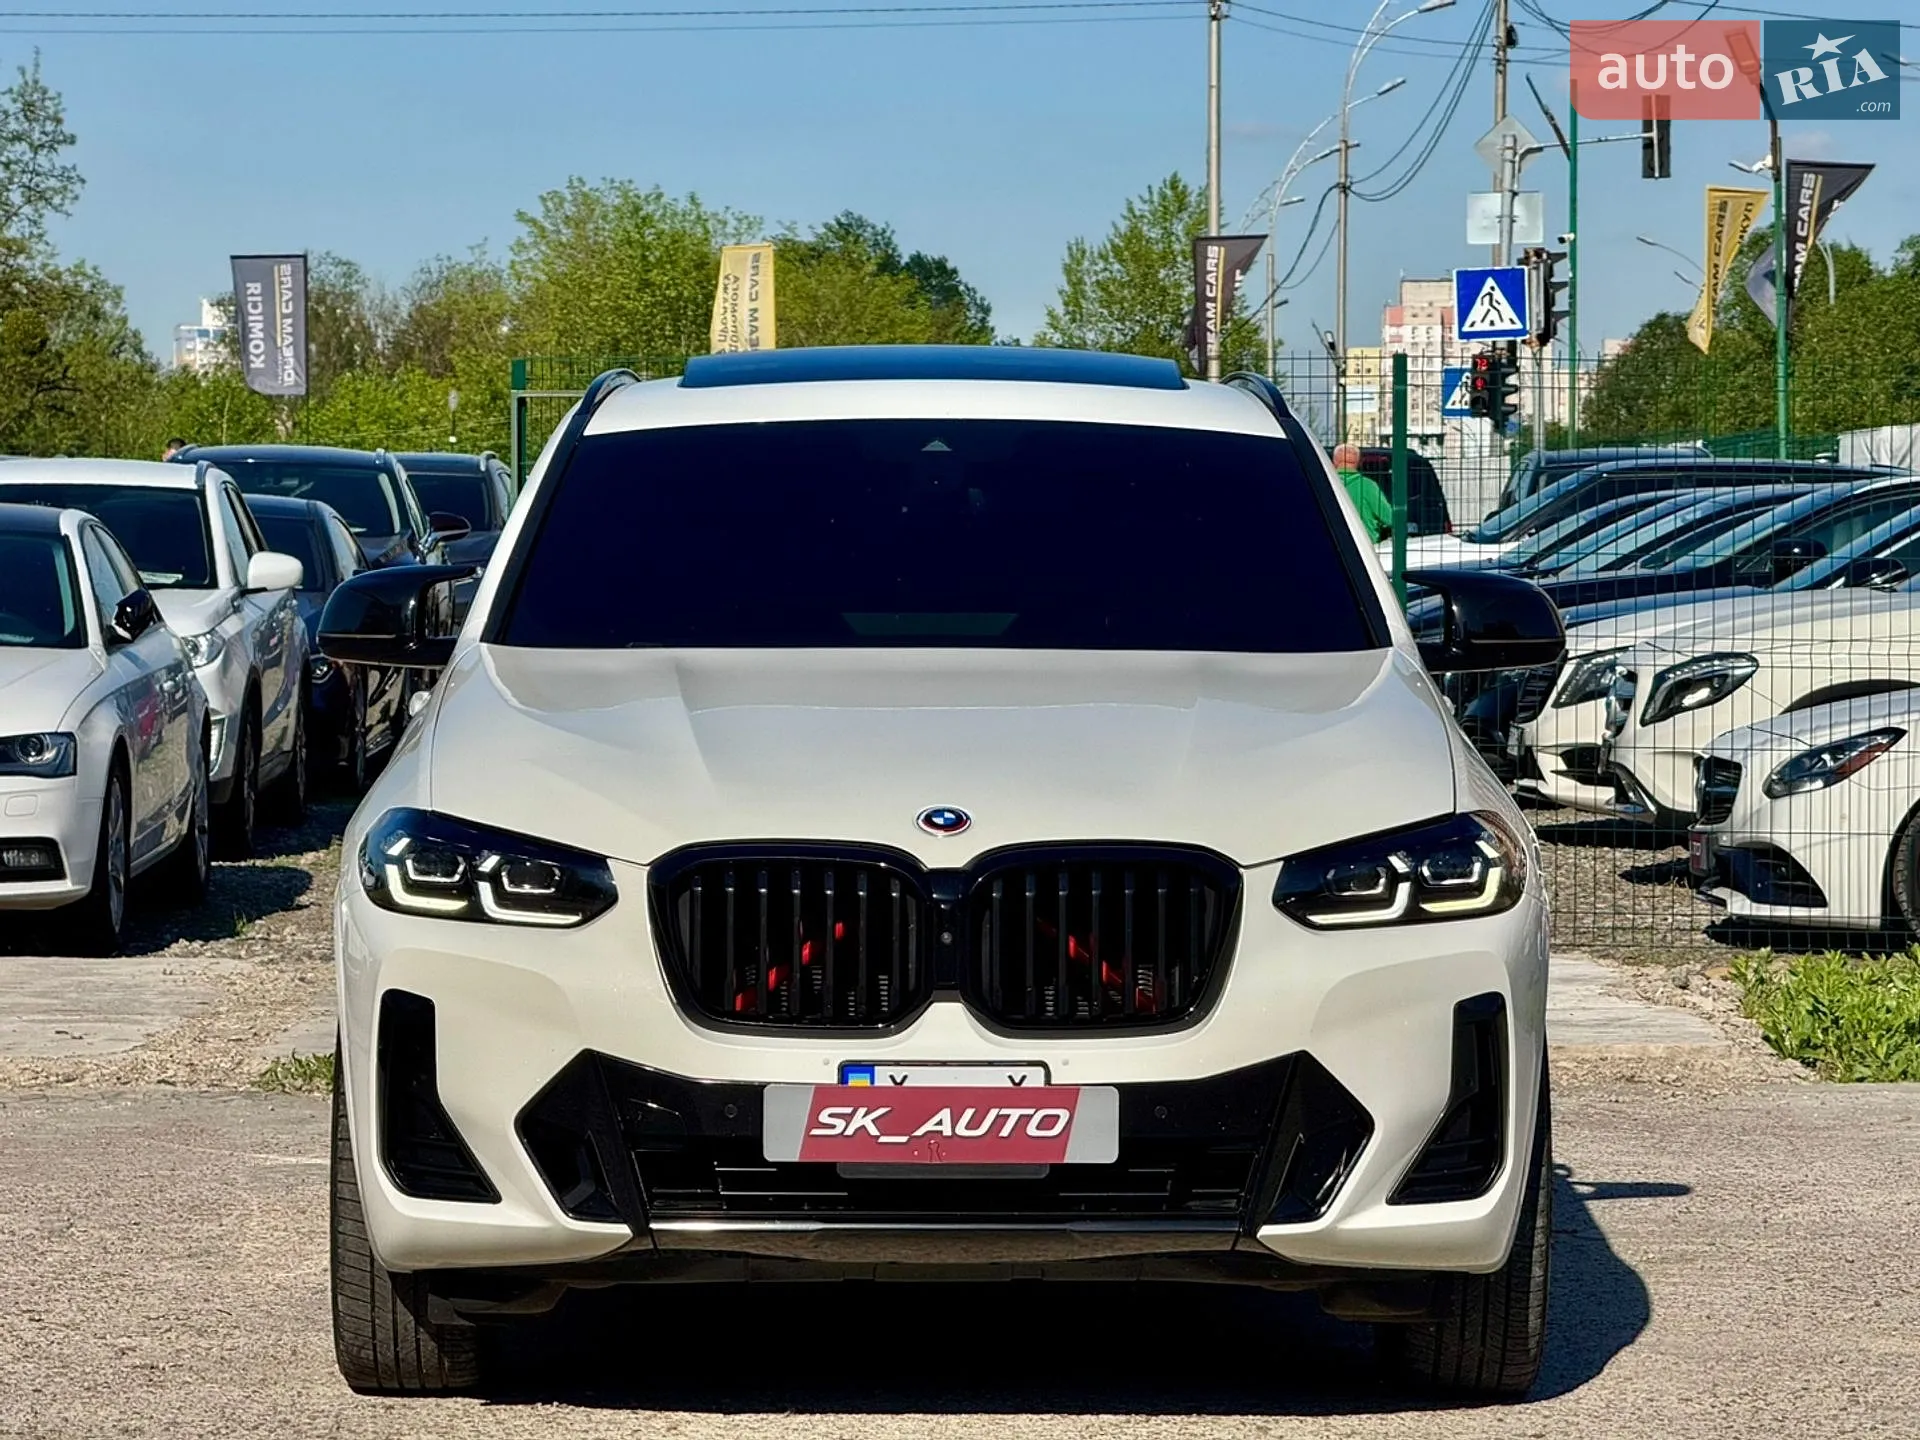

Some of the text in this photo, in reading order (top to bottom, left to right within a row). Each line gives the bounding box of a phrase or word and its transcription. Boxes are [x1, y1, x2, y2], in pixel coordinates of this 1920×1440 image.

[1714, 200, 1728, 257] CARS
[1796, 172, 1816, 237] CARS
[1206, 245, 1219, 356] REAM CARS
[808, 1106, 1071, 1143] SK_AUTO
